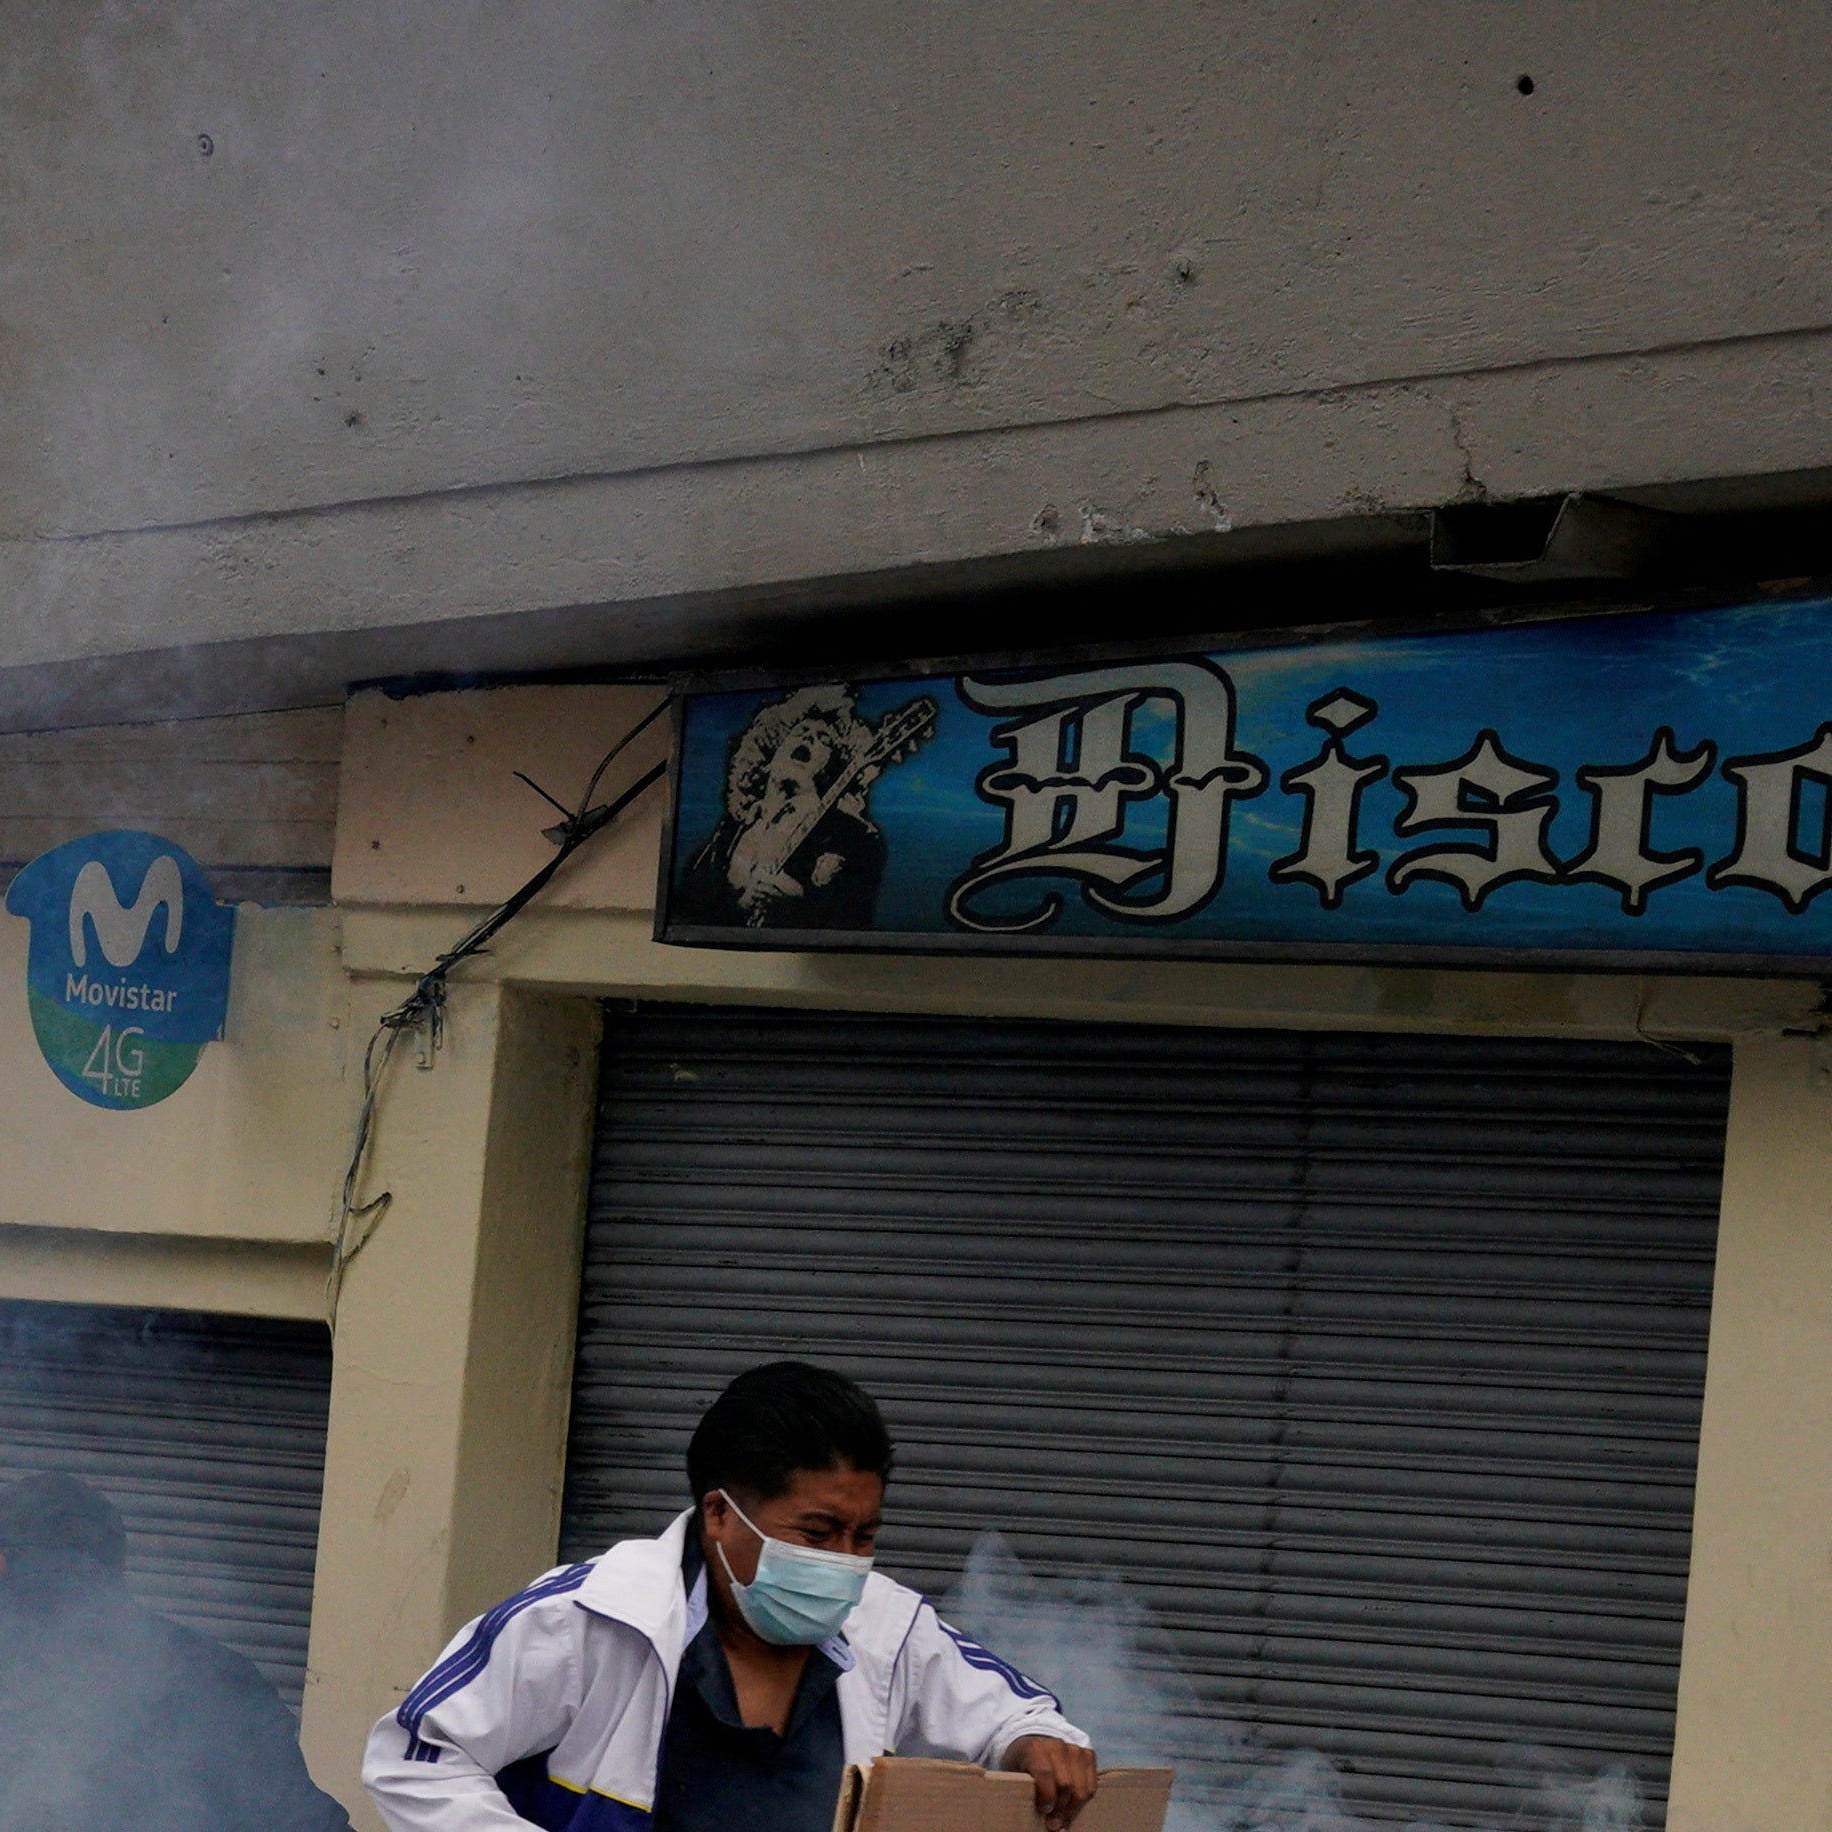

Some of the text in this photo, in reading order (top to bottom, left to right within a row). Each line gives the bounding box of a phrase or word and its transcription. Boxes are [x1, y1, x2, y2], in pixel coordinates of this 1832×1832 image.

[65, 973, 178, 1014] Movistar
[82, 1024, 145, 1096] 4G
[114, 1078, 142, 1098] LTE
